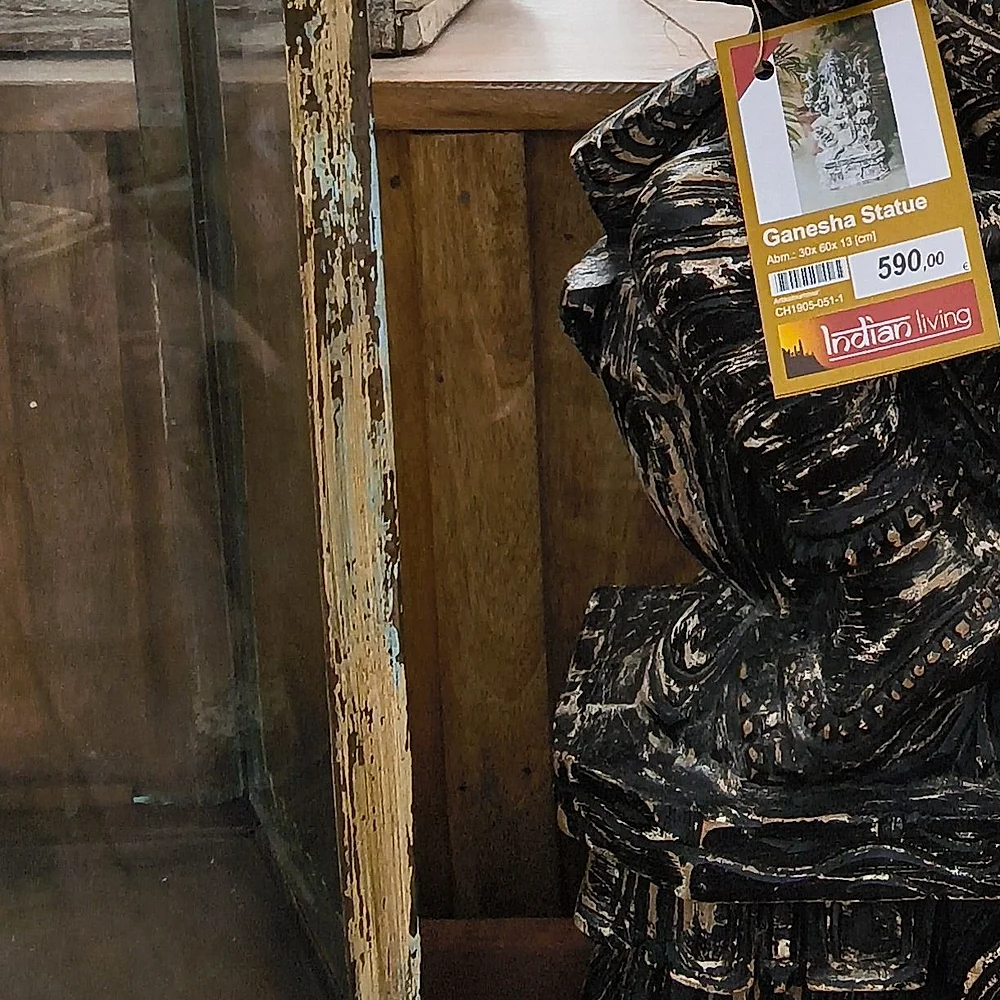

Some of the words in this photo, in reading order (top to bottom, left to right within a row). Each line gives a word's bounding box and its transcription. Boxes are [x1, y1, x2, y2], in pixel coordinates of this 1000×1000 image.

[762, 214, 857, 247] Ganesha
[862, 196, 928, 224] Statue
[798, 246, 818, 258] 30x
[819, 241, 838, 253] 60x
[841, 237, 853, 248] 13
[878, 248, 945, 280] 590,00
[962, 261, 970, 271] €
[774, 293, 844, 317] CH1905-051-1
[820, 315, 911, 356] Indian
[916, 307, 973, 334] living
